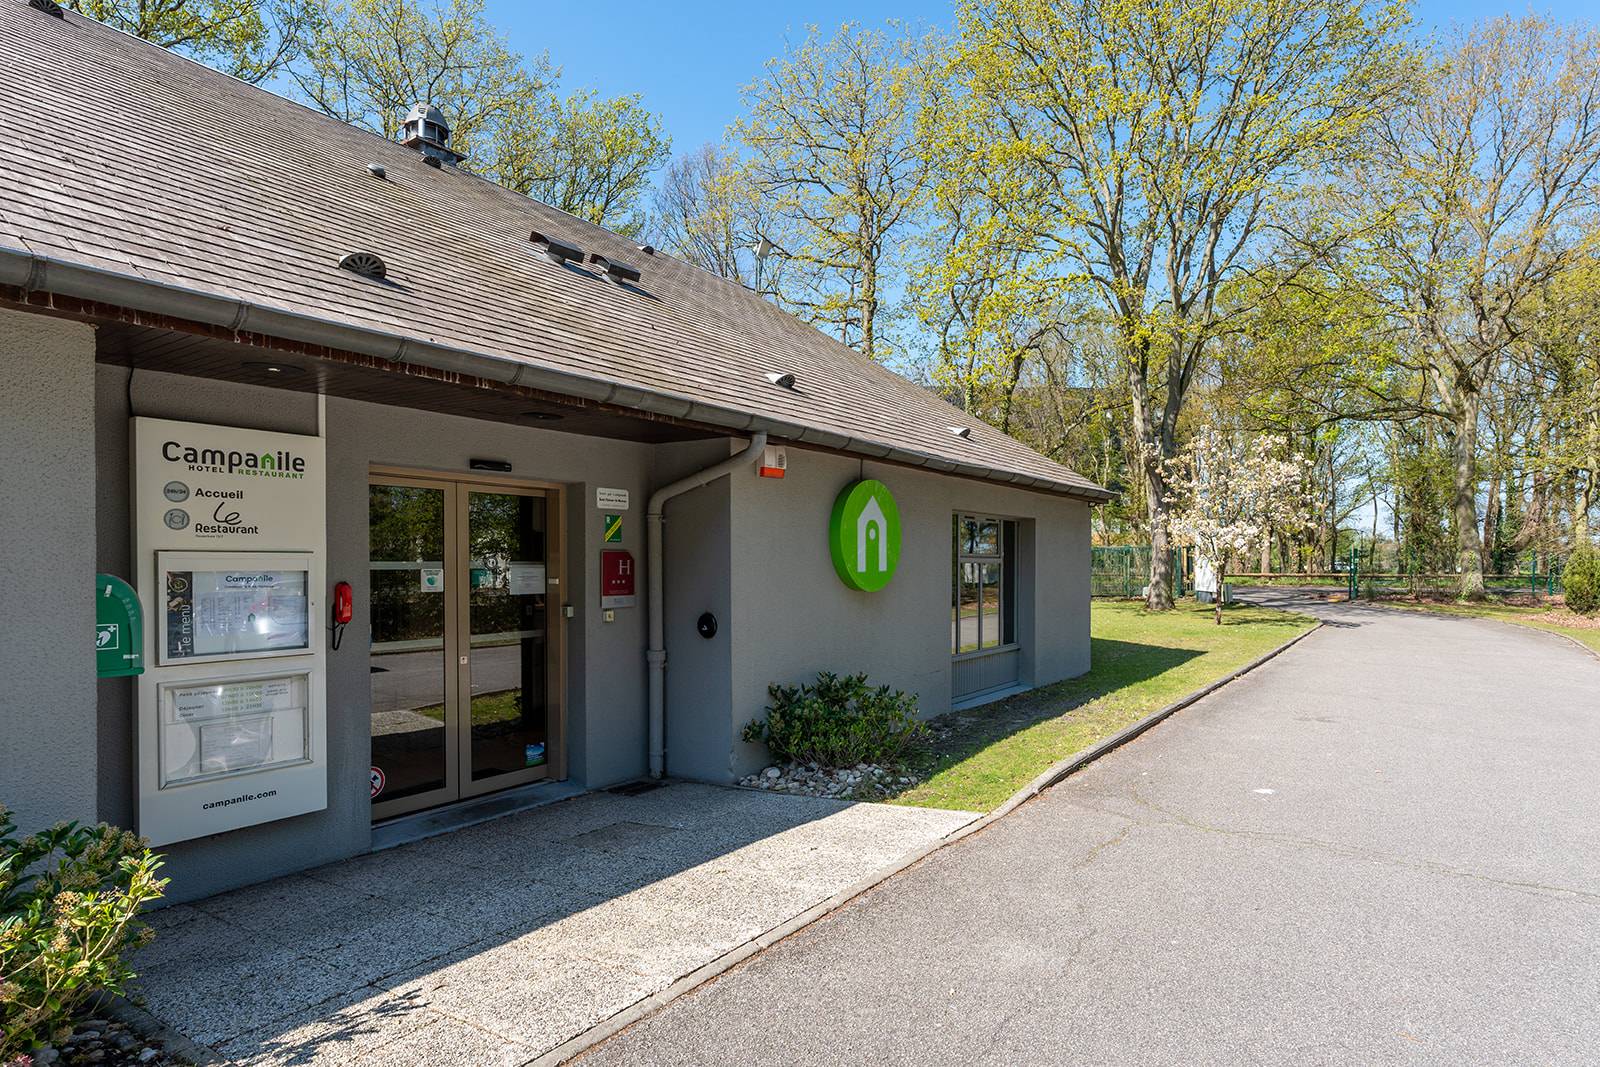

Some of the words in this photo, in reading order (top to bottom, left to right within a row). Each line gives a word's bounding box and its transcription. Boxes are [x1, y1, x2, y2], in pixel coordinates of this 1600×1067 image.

[162, 441, 305, 473] Campanile
[188, 465, 224, 474] HOTEL
[238, 469, 304, 479] RESTAURANT
[195, 488, 243, 499] Accueil
[195, 523, 259, 534] Restaurant
[619, 559, 631, 576] H
[225, 574, 274, 584] Campanile
[181, 604, 191, 634] menu
[202, 789, 278, 810] campanile.com
